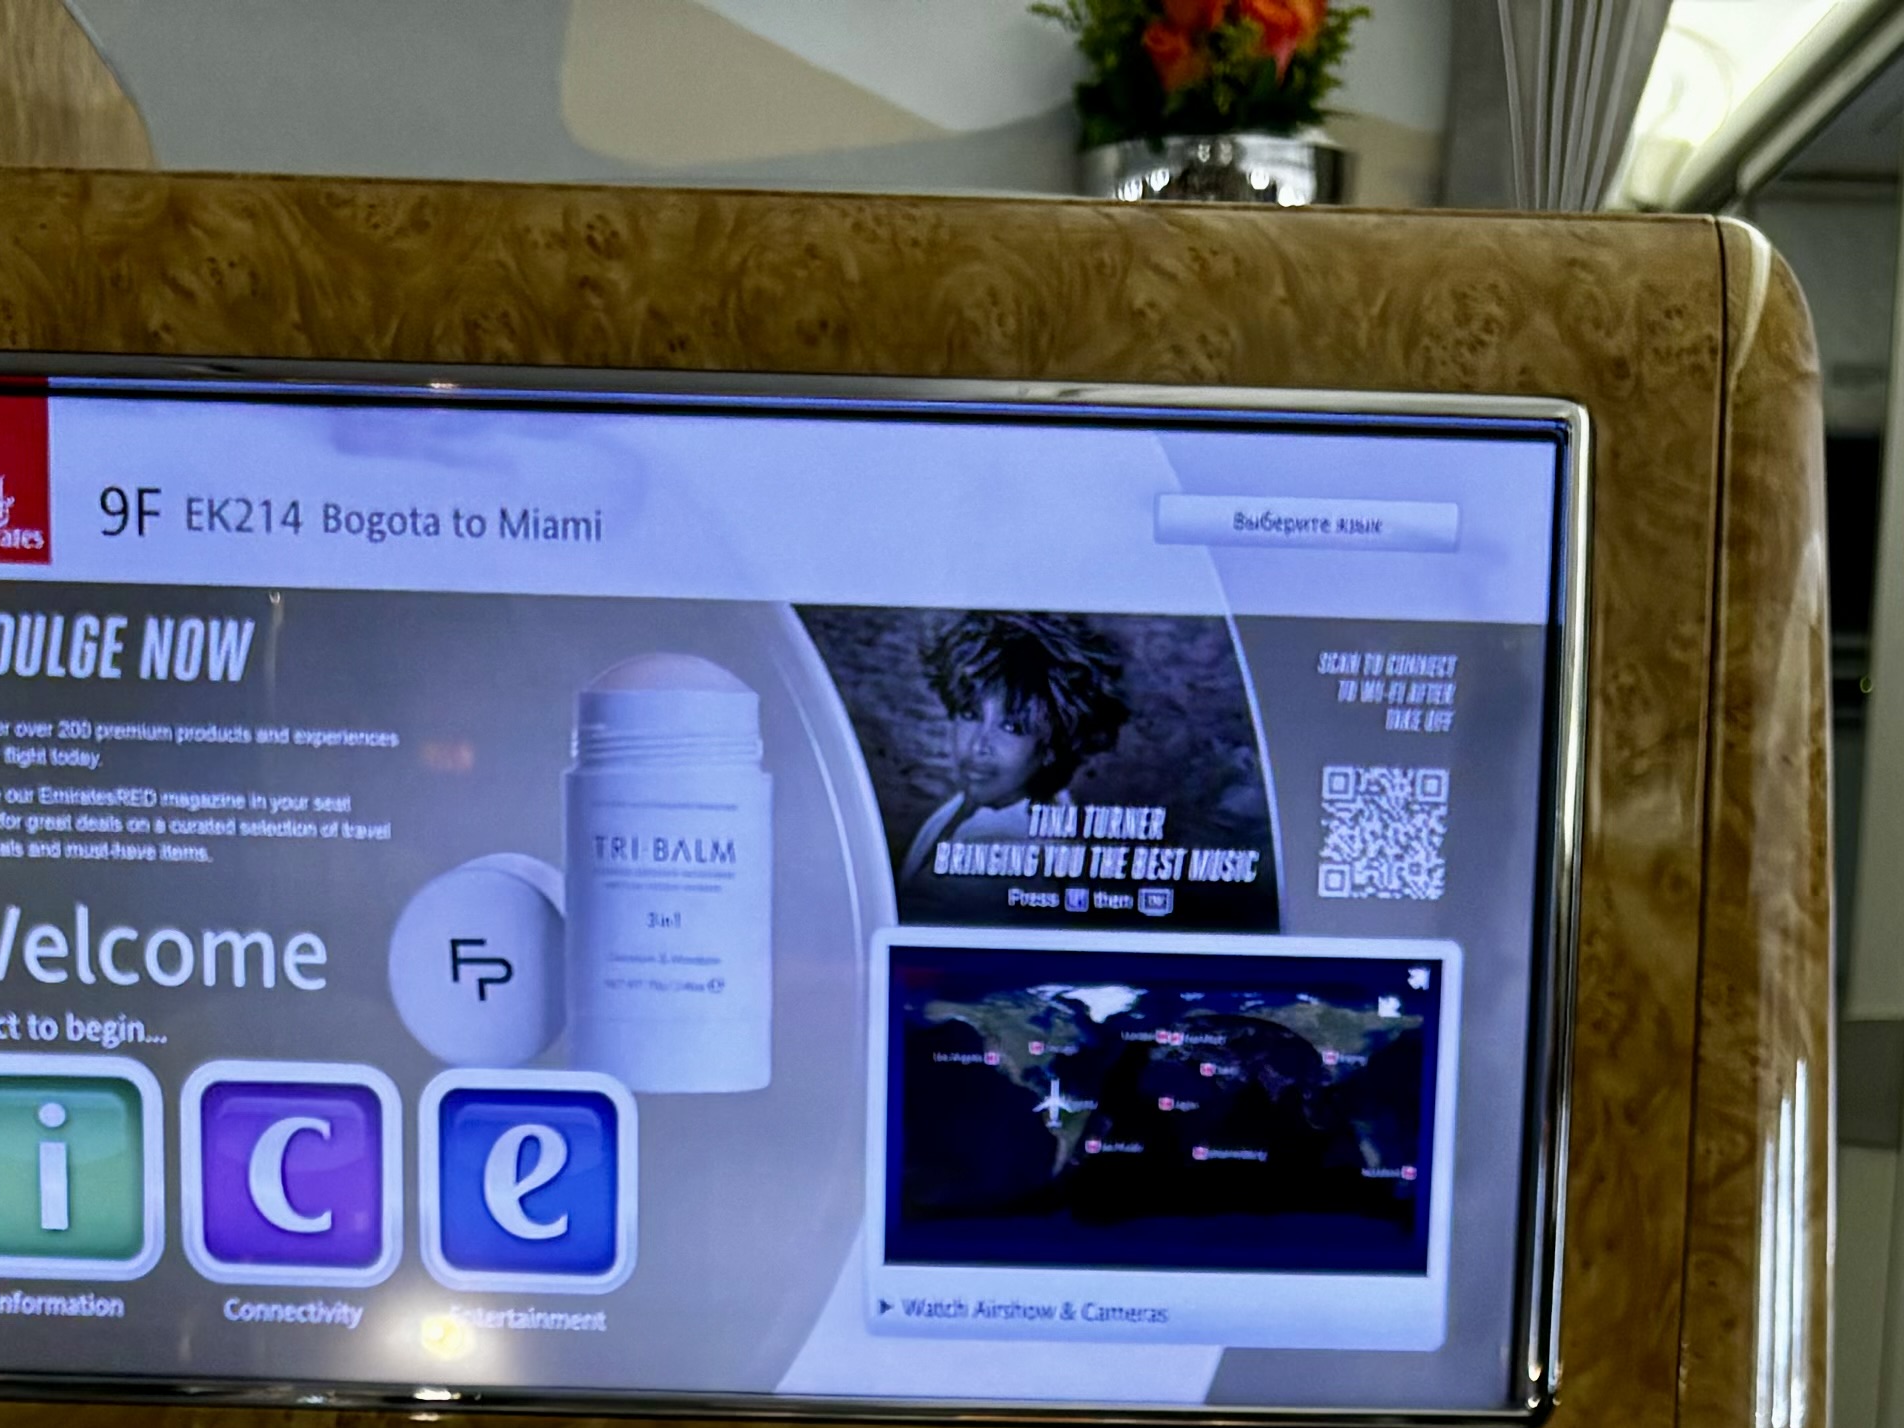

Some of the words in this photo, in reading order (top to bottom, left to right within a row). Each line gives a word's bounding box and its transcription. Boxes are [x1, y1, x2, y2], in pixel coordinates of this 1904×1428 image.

[99, 485, 162, 537] 9F
[186, 497, 303, 535] EK214
[322, 502, 440, 543] Bogota
[453, 510, 486, 538] to
[499, 507, 603, 542] Miami
[1233, 510, 1330, 536] Выберите
[139, 617, 256, 682] NOW
[14, 723, 52, 738] over
[176, 724, 251, 744] products
[256, 727, 288, 744] and
[294, 729, 399, 747] experiences
[4, 747, 46, 768] flight
[5, 789, 34, 803] our
[160, 792, 245, 810] magazine
[269, 797, 309, 814] your
[312, 796, 351, 812] seat
[0, 814, 22, 831] for
[26, 816, 72, 835] great
[76, 816, 122, 833] deals
[170, 819, 236, 836] curated
[240, 820, 317, 837] selection
[341, 822, 392, 840] travel
[1083, 805, 1167, 840] TURNER
[28, 842, 61, 858] and
[65, 844, 156, 860] must-have
[934, 842, 1040, 876] BRINGING
[1044, 845, 1086, 878] YOU
[1090, 846, 1130, 880] THE
[1131, 847, 1188, 881] BEST
[1189, 848, 1260, 883] MUSIC
[1008, 888, 1059, 907] Press
[27, 1013, 59, 1042] to
[65, 1013, 168, 1049] begin...
[38, 1101, 70, 1230] i
[223, 1298, 364, 1330] Connectivity
[902, 1298, 968, 1318] Watch
[972, 1299, 1057, 1320] Airshow
[1059, 1302, 1076, 1321] &
[1081, 1302, 1169, 1323] Cameras
